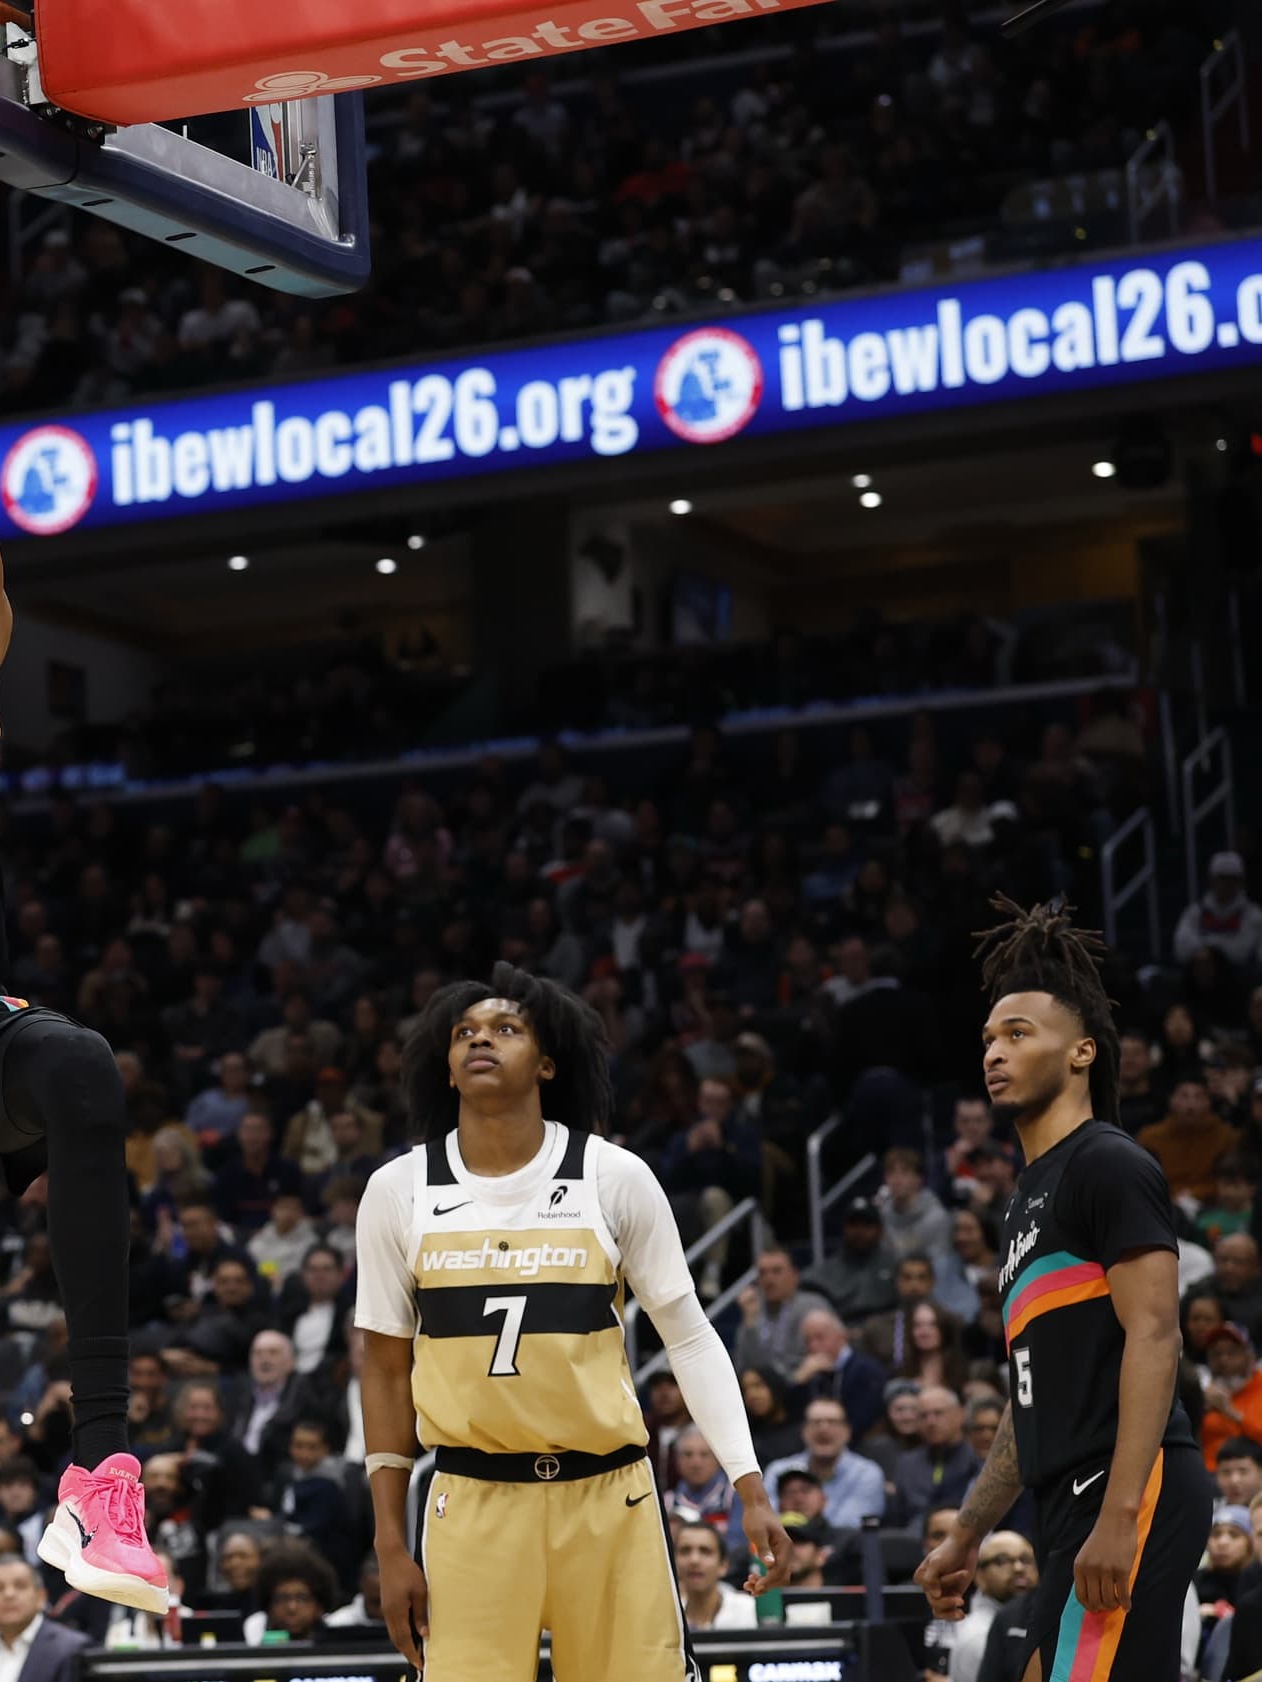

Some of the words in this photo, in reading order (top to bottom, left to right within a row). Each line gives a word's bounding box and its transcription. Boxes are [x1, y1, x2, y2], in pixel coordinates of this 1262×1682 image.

[379, 17, 638, 76] State
[110, 366, 639, 506] ibewlocal26.org
[537, 1210, 581, 1220] Robinhood
[421, 1237, 588, 1276] washington
[482, 1295, 528, 1377] 7
[1013, 1346, 1034, 1409] 5
